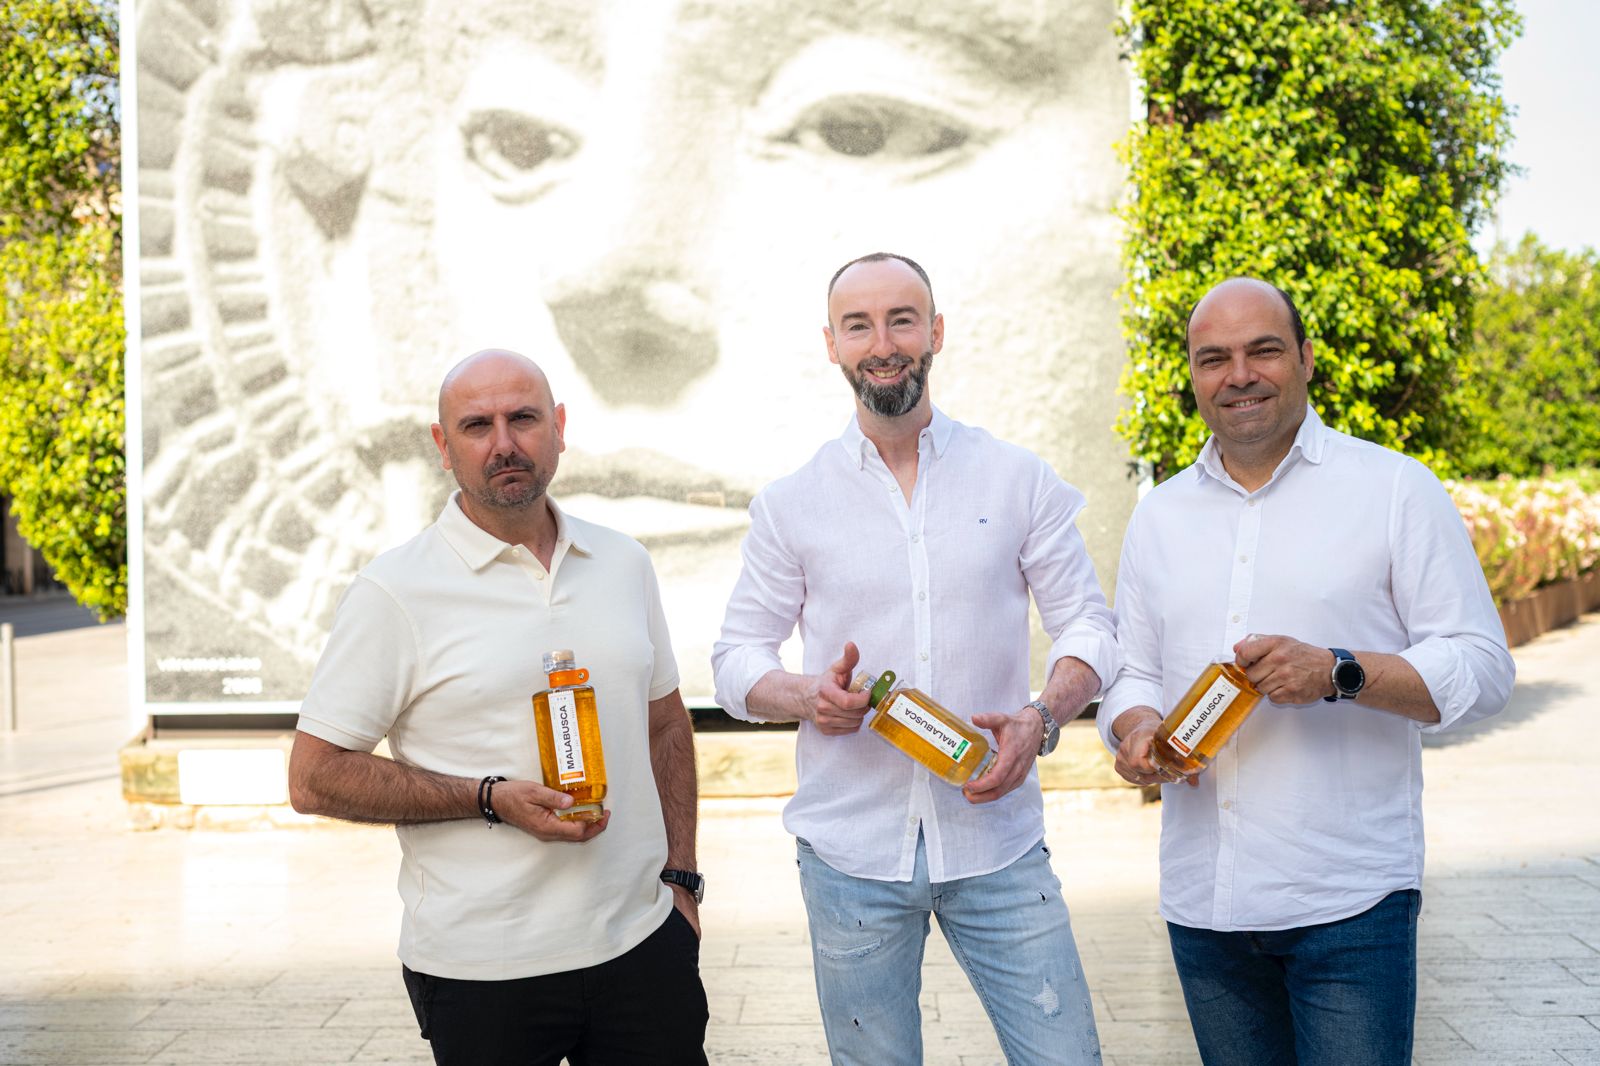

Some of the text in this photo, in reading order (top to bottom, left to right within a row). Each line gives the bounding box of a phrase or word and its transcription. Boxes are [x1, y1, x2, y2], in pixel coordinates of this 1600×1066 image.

[559, 705, 575, 770] MALABUSCA
[904, 707, 957, 748] MALABUSCA
[1182, 692, 1225, 743] MALABUSCA
